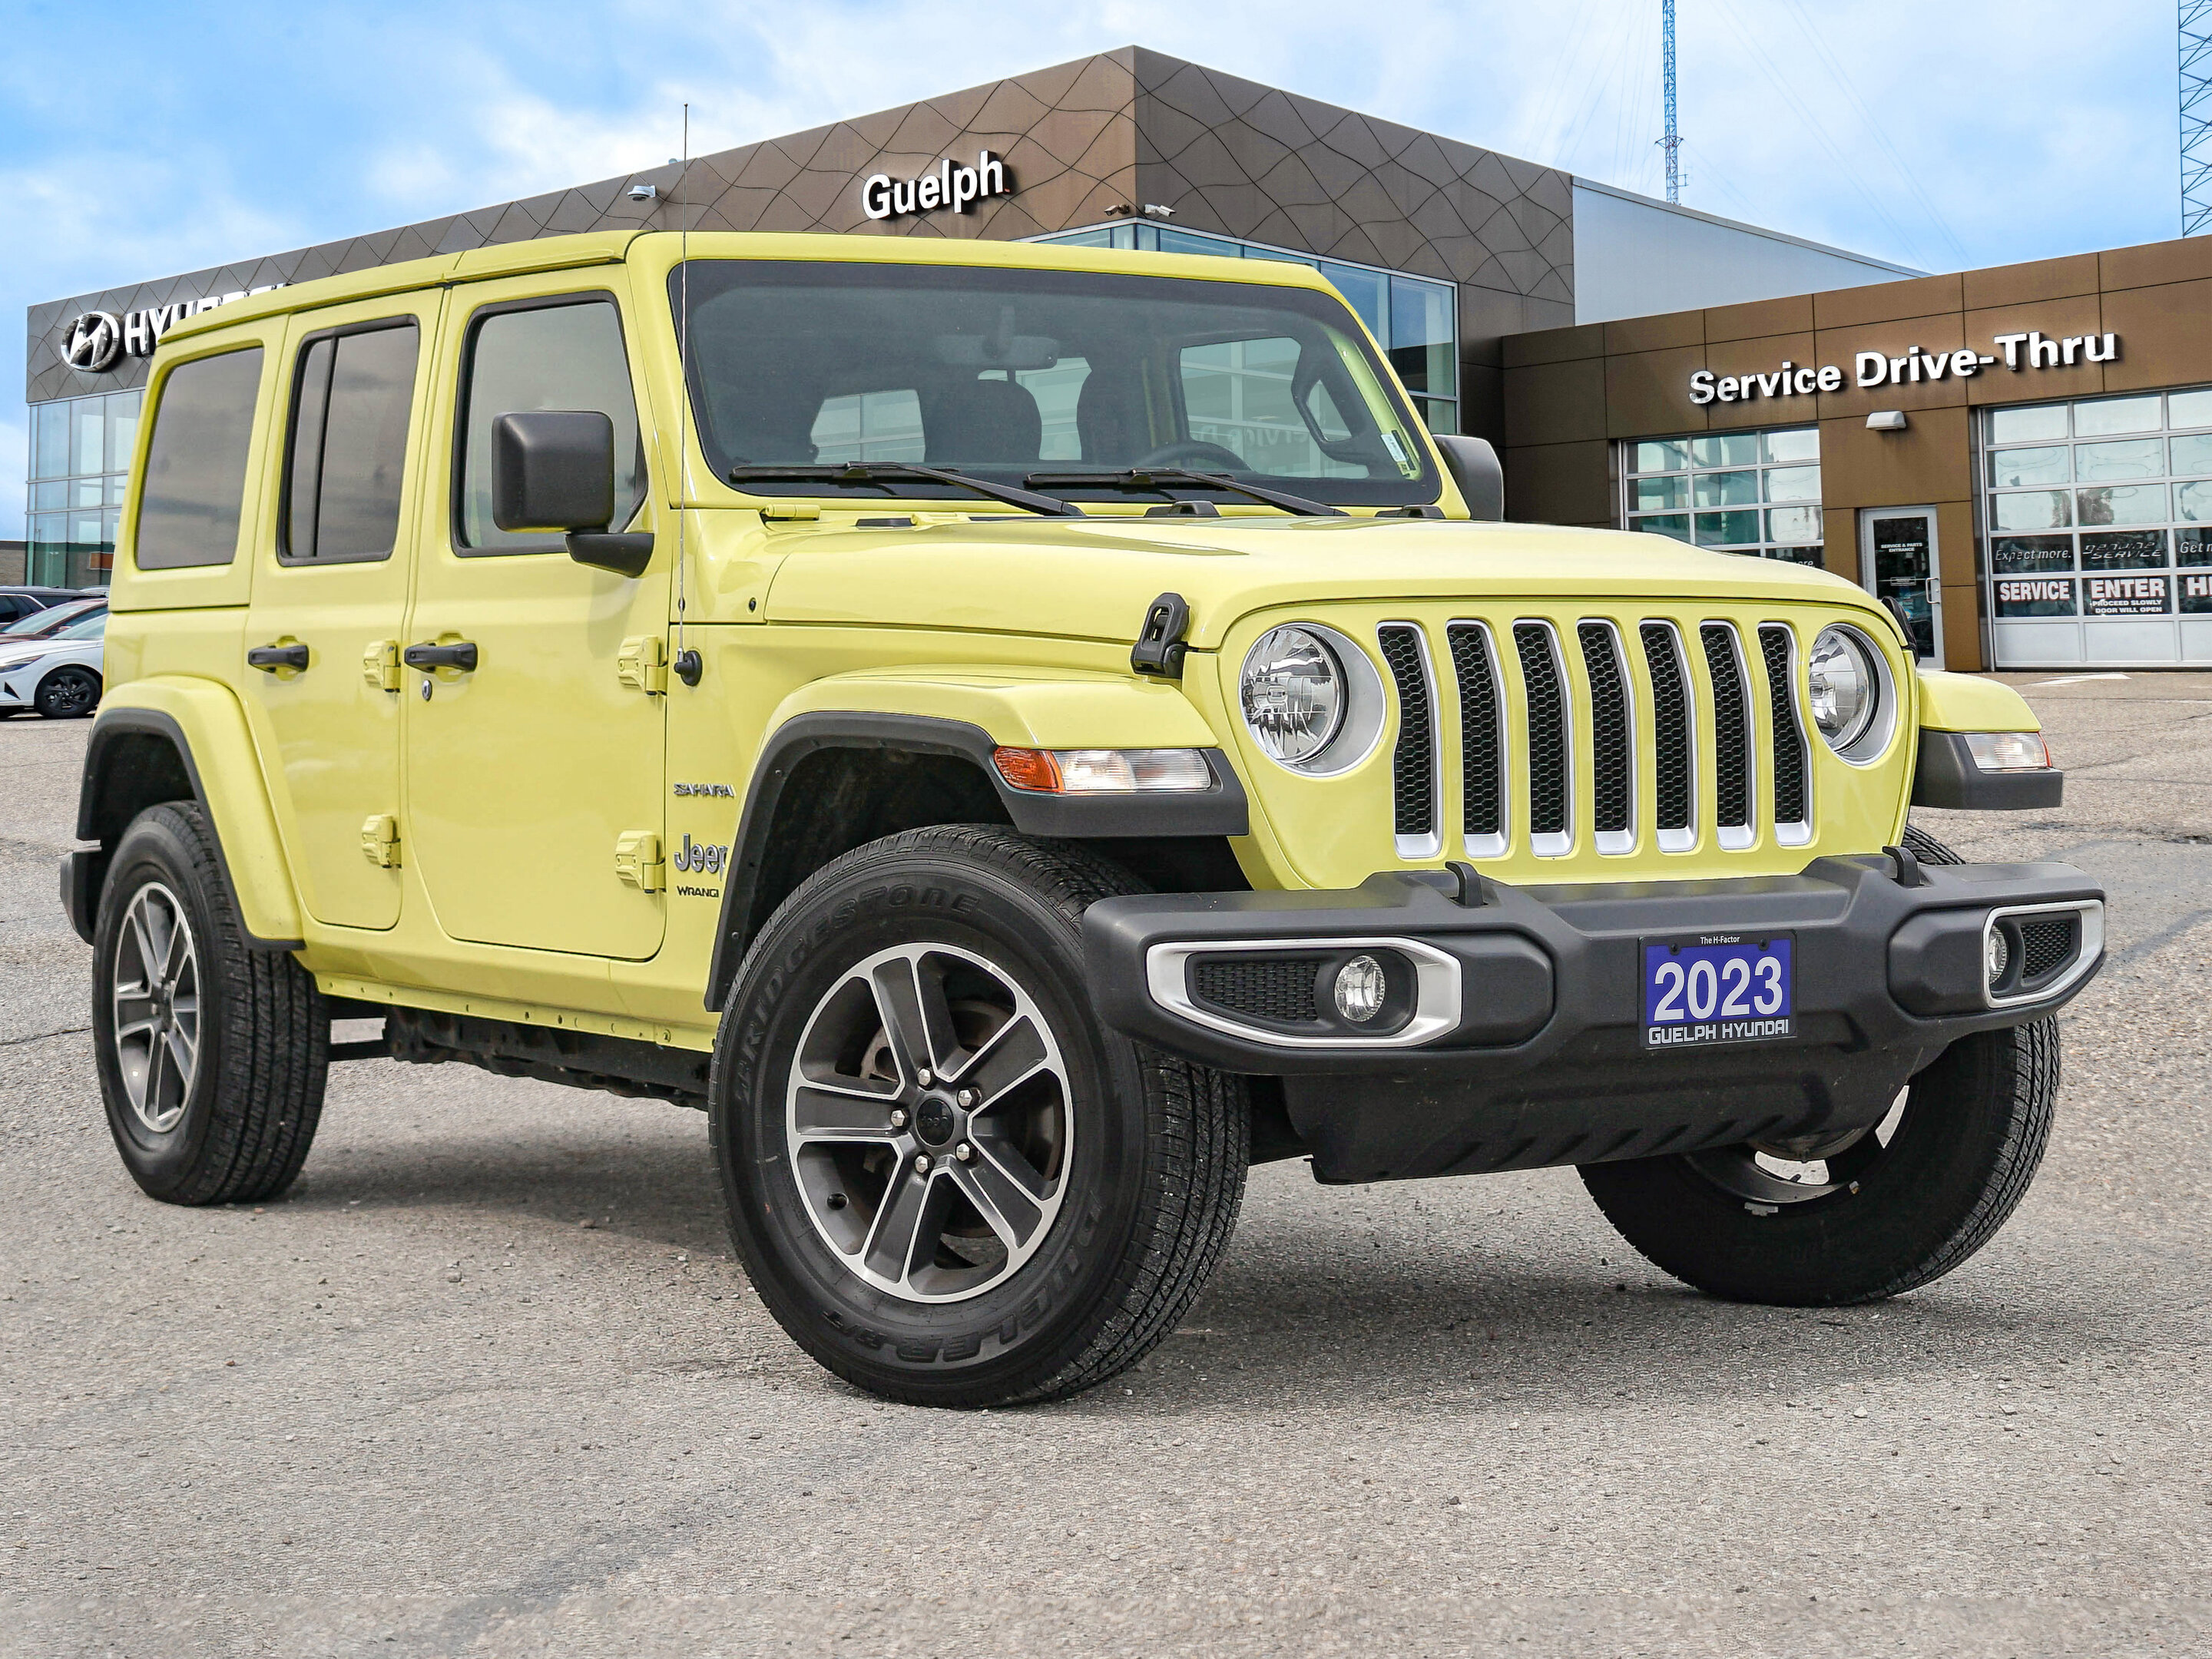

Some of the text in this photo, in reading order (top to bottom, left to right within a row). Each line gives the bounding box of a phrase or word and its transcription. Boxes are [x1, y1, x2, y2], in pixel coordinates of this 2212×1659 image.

[862, 150, 1004, 220] Guelph
[1690, 331, 2117, 404] Service Drive-Thru
[1995, 549, 2072, 562] Expect more.
[2180, 541, 2204, 554] Get
[1999, 581, 2071, 601] SERVICE
[2091, 578, 2166, 599] ENTER
[2186, 576, 2212, 596] H
[674, 783, 737, 797] SAHARA
[674, 833, 729, 882] Jeep
[1700, 935, 1740, 945] The H-Factor
[1654, 955, 1783, 1022] 2023
[1648, 1018, 1790, 1045] GUELPH HYUNDAI
